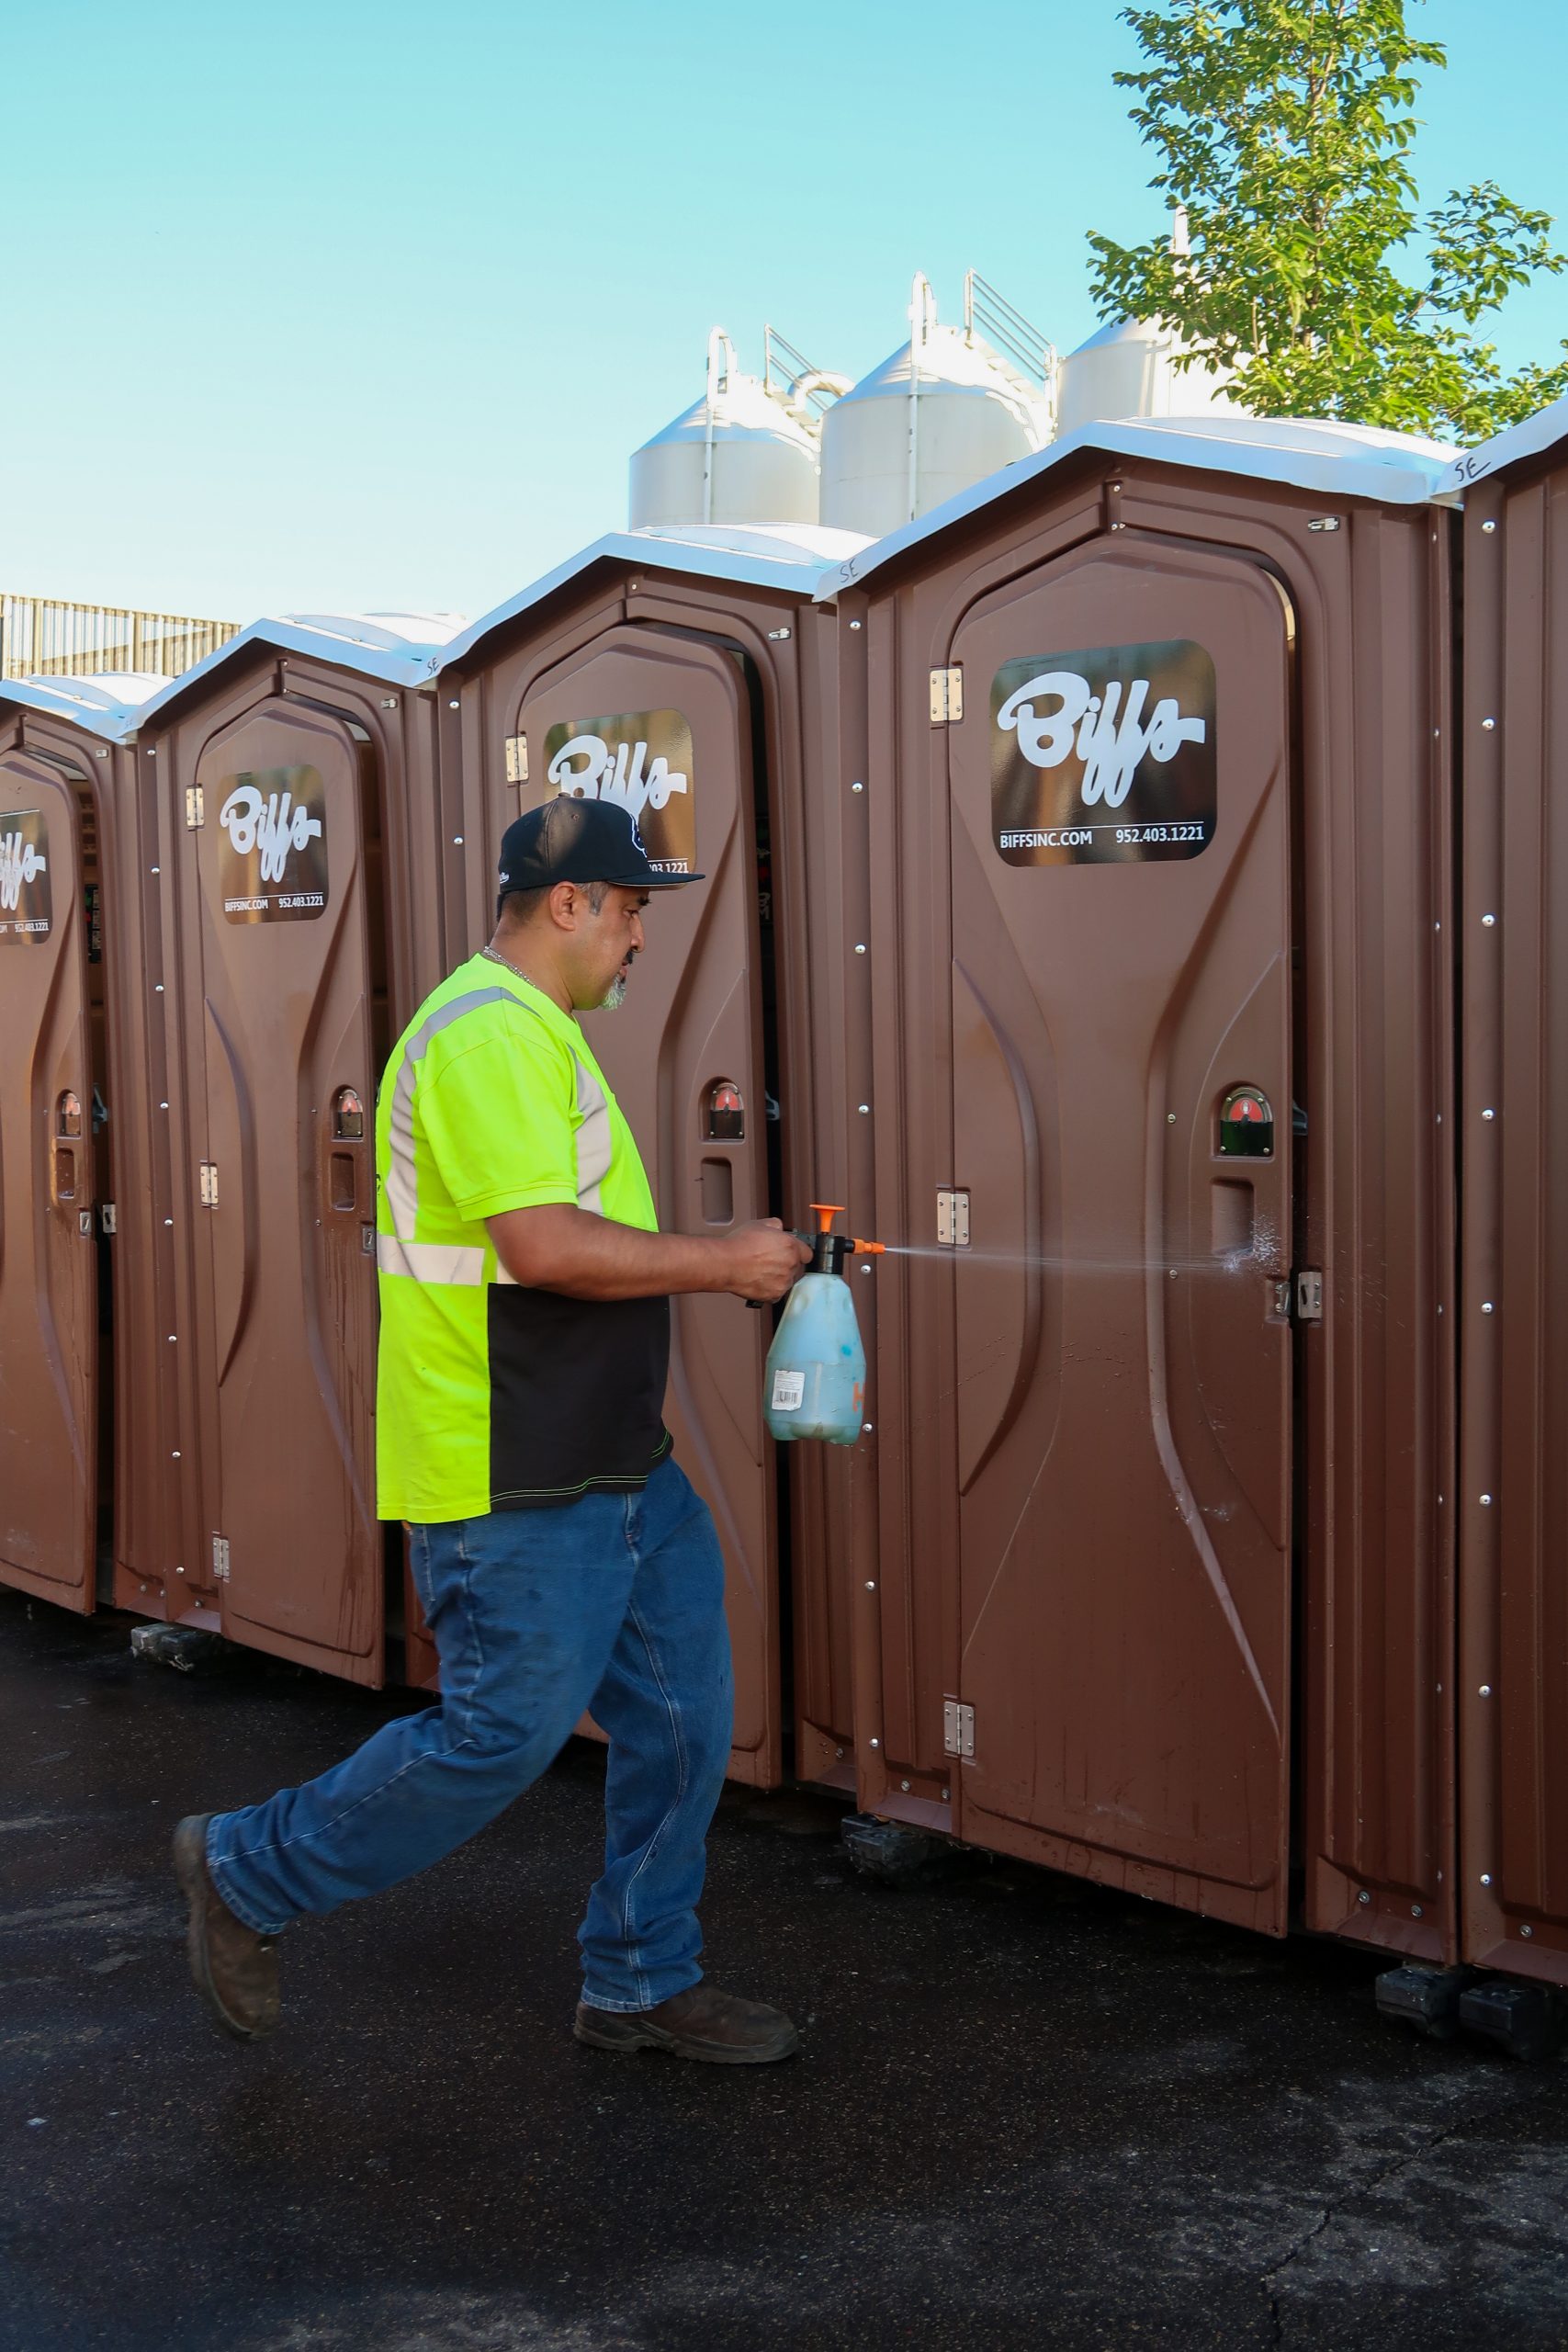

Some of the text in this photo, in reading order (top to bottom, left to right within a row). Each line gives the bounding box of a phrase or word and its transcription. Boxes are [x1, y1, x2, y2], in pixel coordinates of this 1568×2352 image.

[1454, 457, 1492, 482] SE
[840, 558, 860, 583] SE
[997, 672, 1206, 808] Biffs
[220, 786, 321, 883] Biffs
[1000, 825, 1205, 849] BIFFSINC.COM 952.403.1221
[0, 831, 46, 911] iffs
[224, 895, 324, 912] BIFFSINC.COM 952.403.1221
